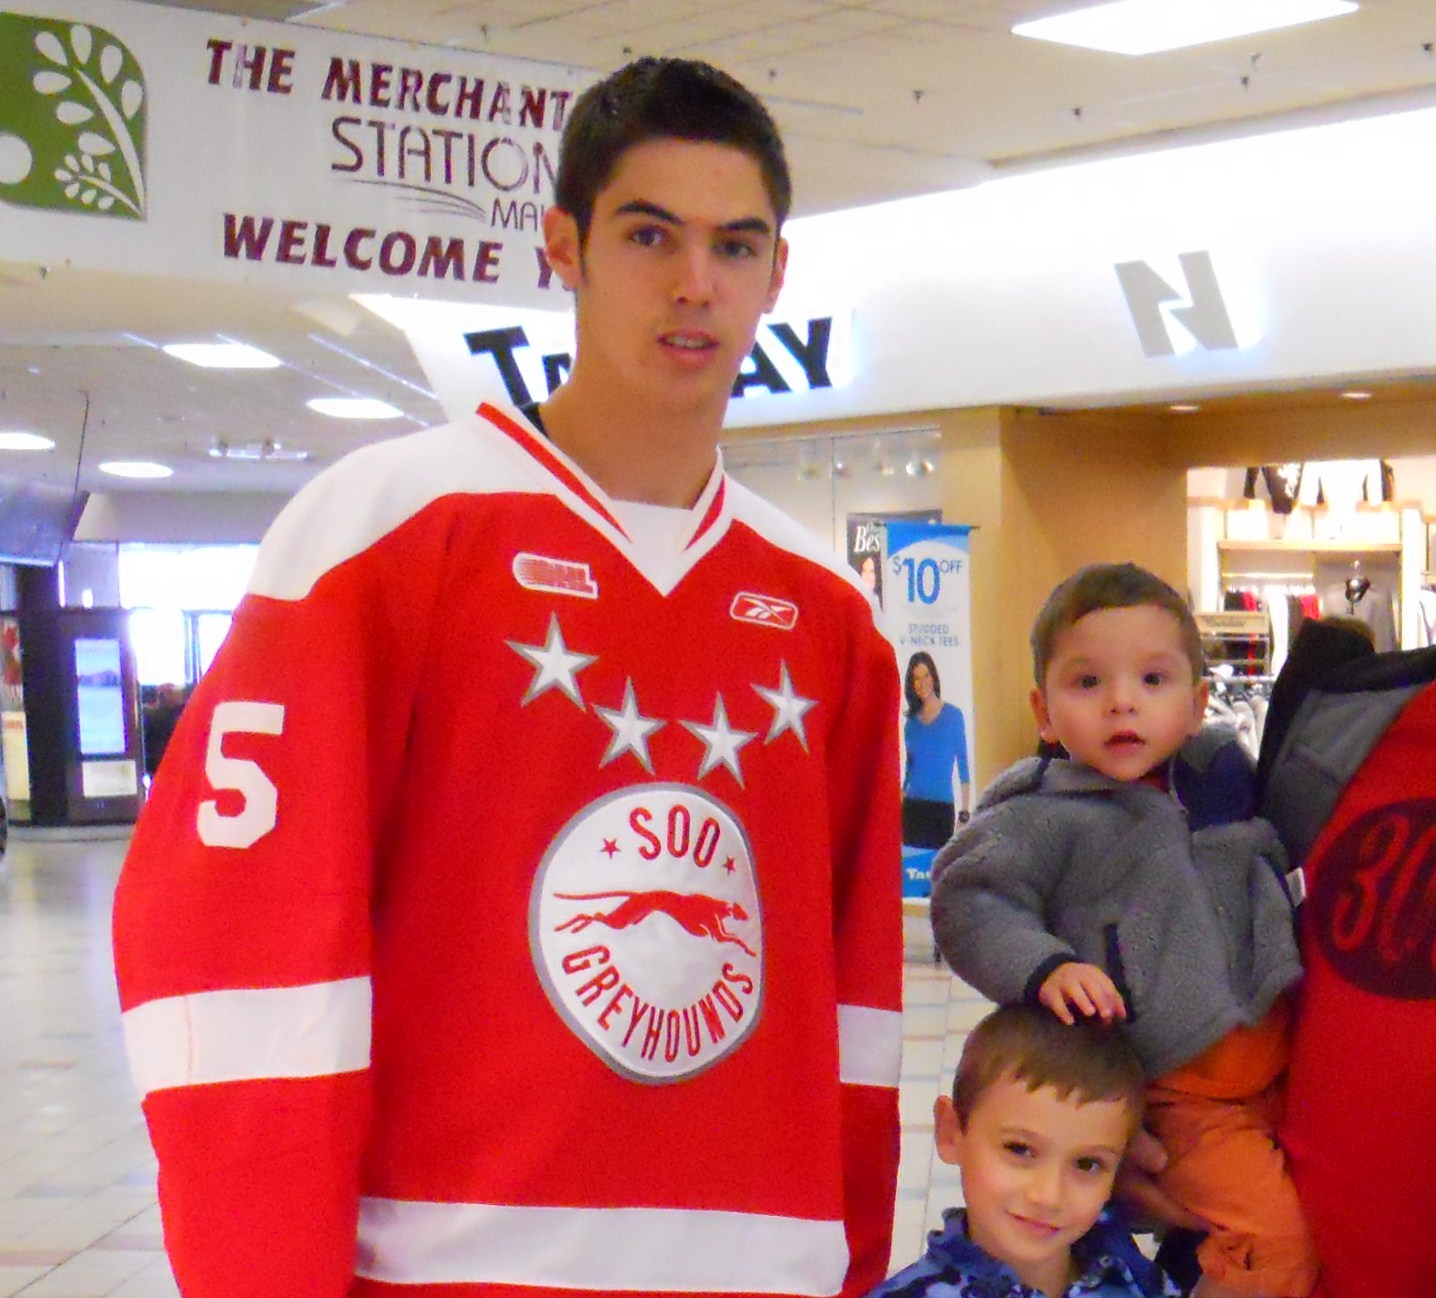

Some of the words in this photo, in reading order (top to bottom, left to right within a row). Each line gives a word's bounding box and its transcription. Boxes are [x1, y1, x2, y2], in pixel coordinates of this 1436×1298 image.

[206, 38, 296, 94] THE
[223, 212, 503, 284] WELCOME
[893, 556, 940, 605] $10
[940, 559, 963, 574] OFF
[197, 701, 285, 849] 5
[629, 804, 721, 868] SOO
[562, 944, 753, 1063] GREYHOUNDS
